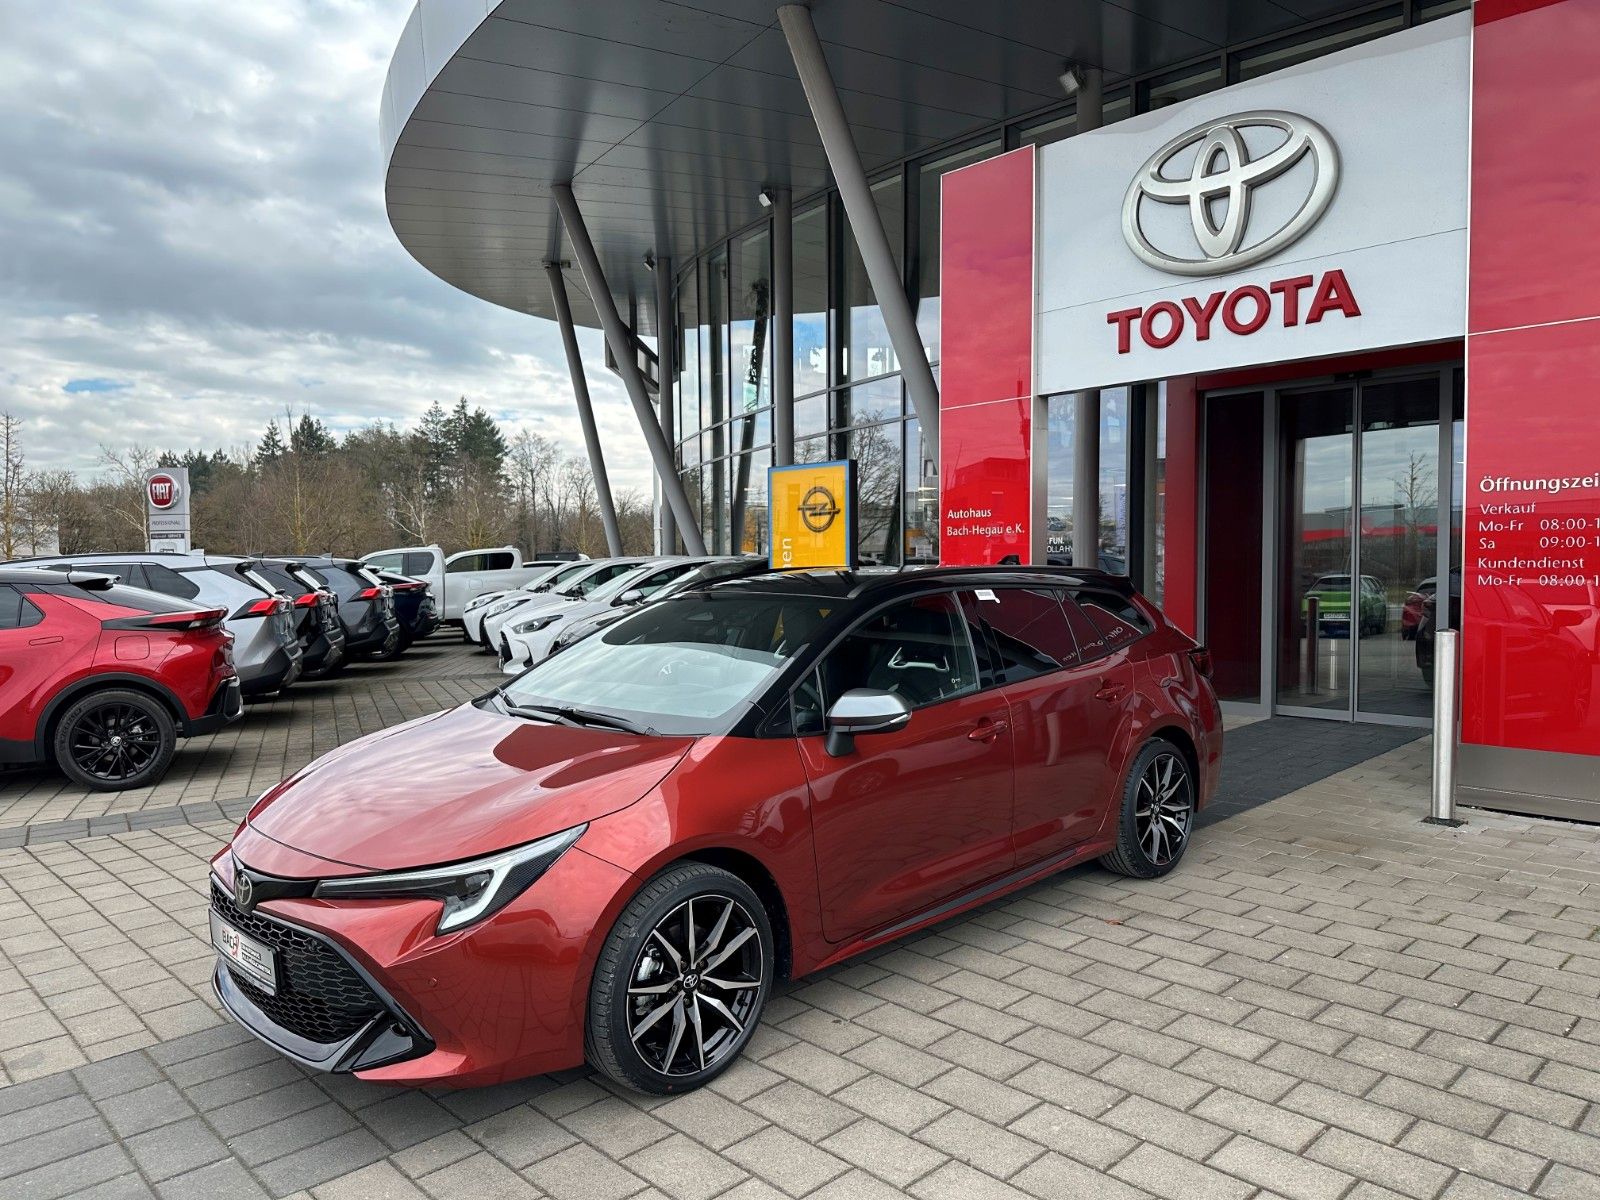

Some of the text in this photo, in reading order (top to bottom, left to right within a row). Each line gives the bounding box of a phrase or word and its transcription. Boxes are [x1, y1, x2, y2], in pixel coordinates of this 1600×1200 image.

[1106, 269, 1362, 354] TOYOTA
[1479, 472, 1599, 494] Öffnungszei
[152, 483, 171, 500] FIAT
[947, 507, 992, 519] Autohaus
[1479, 501, 1536, 515] Verkauf
[946, 523, 1025, 538] Bach-Hegau e.K.
[1478, 519, 1524, 532] Mo-Fr
[1479, 537, 1496, 550] Sa
[1478, 556, 1585, 569] Kundendienst
[1478, 574, 1523, 586] Mo-Fr
